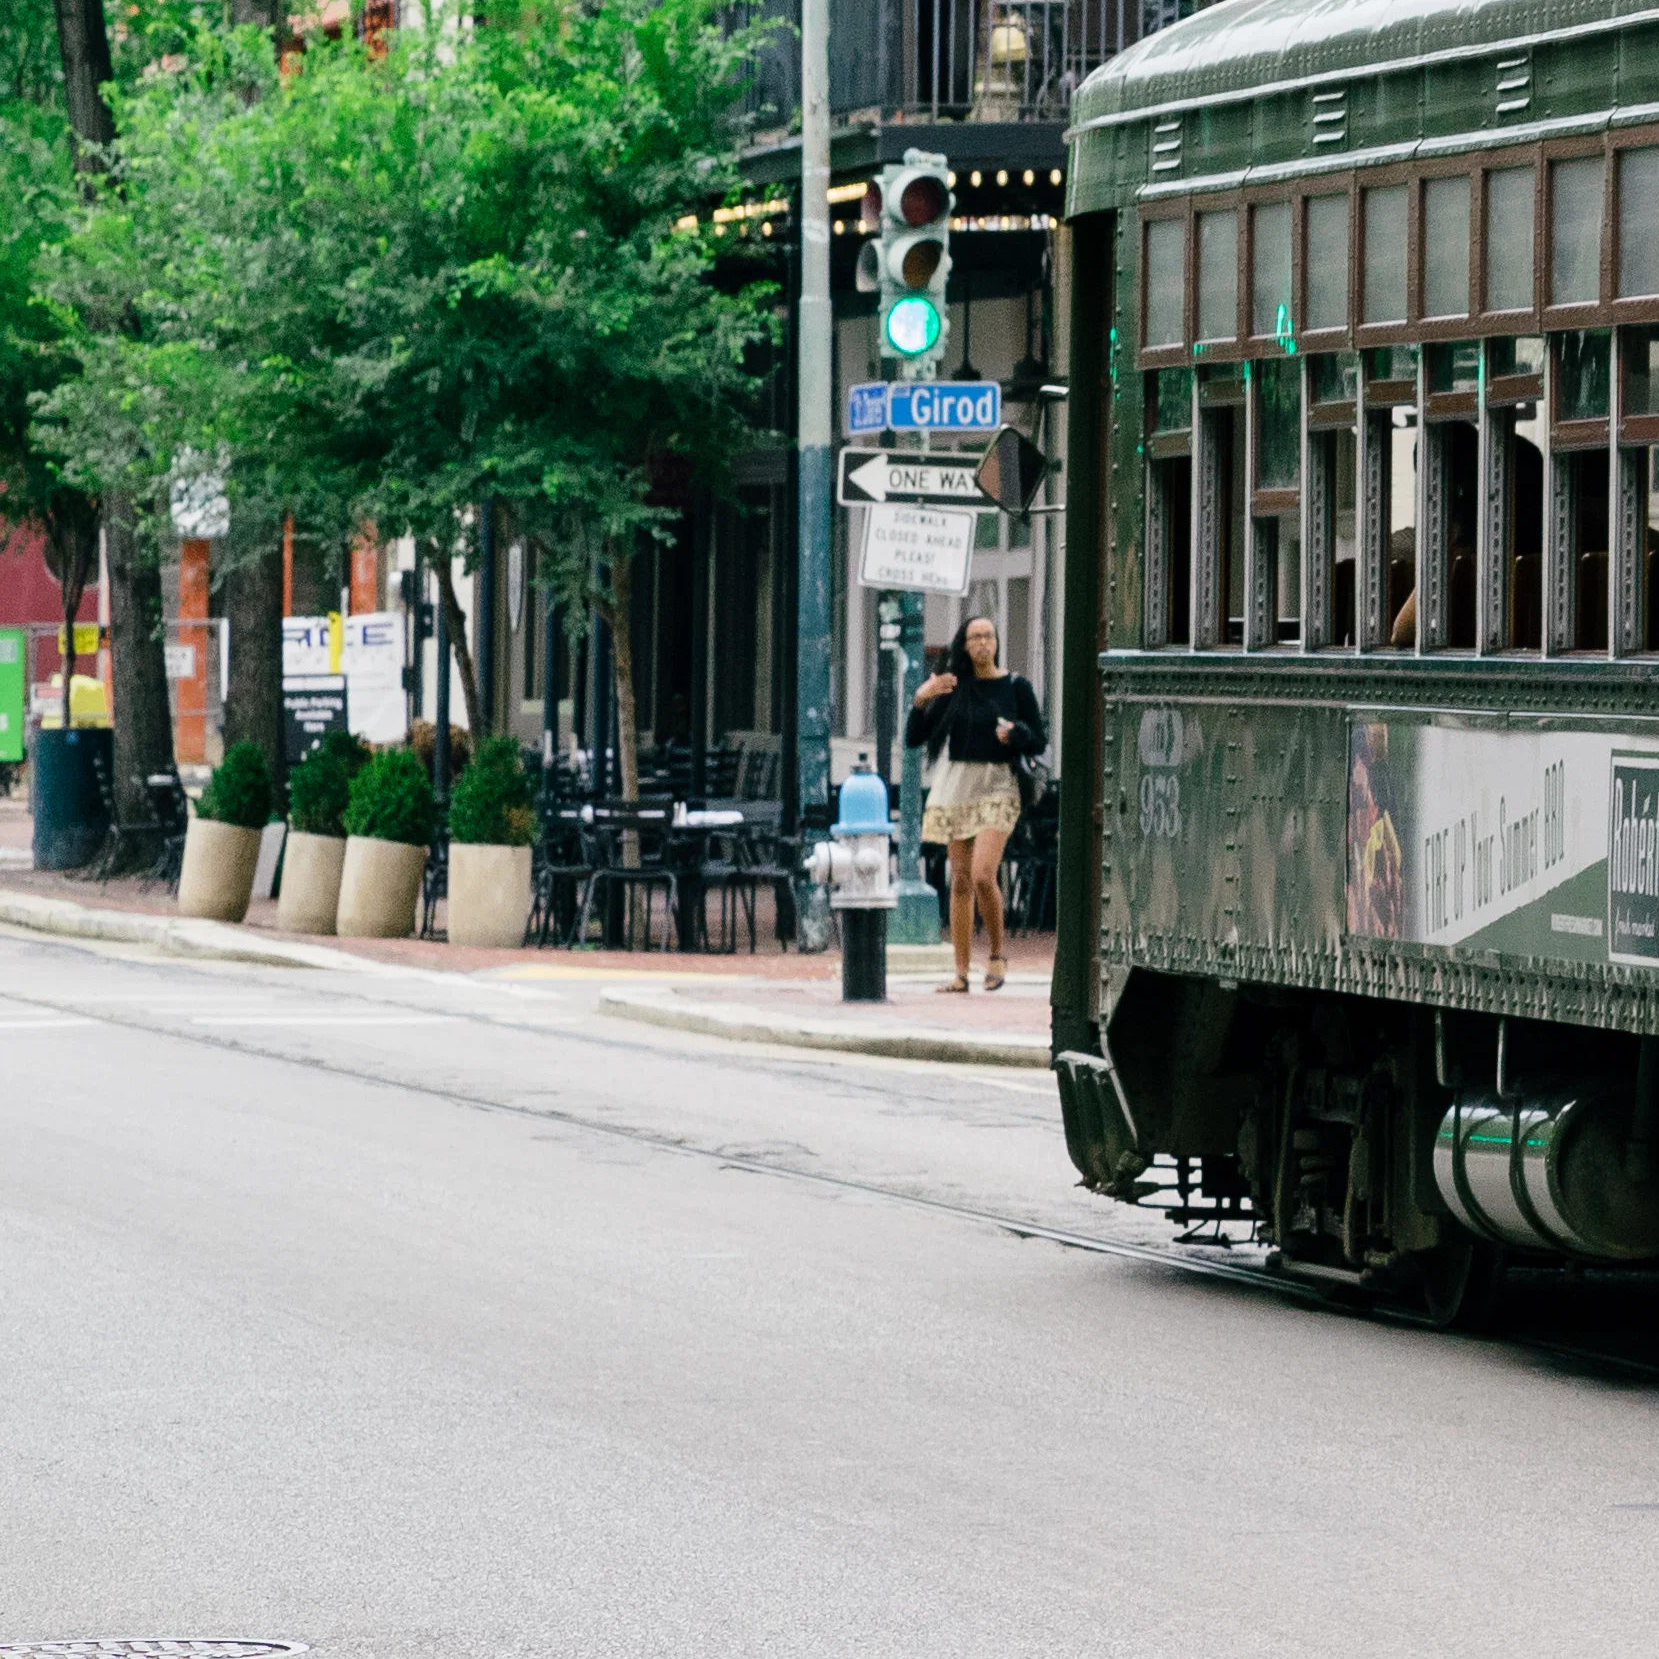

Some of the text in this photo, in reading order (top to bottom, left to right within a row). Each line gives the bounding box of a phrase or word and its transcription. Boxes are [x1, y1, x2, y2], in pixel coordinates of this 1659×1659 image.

[911, 388, 994, 425] Girod
[889, 469, 930, 489] ONE
[1499, 795, 1540, 897] Summer
